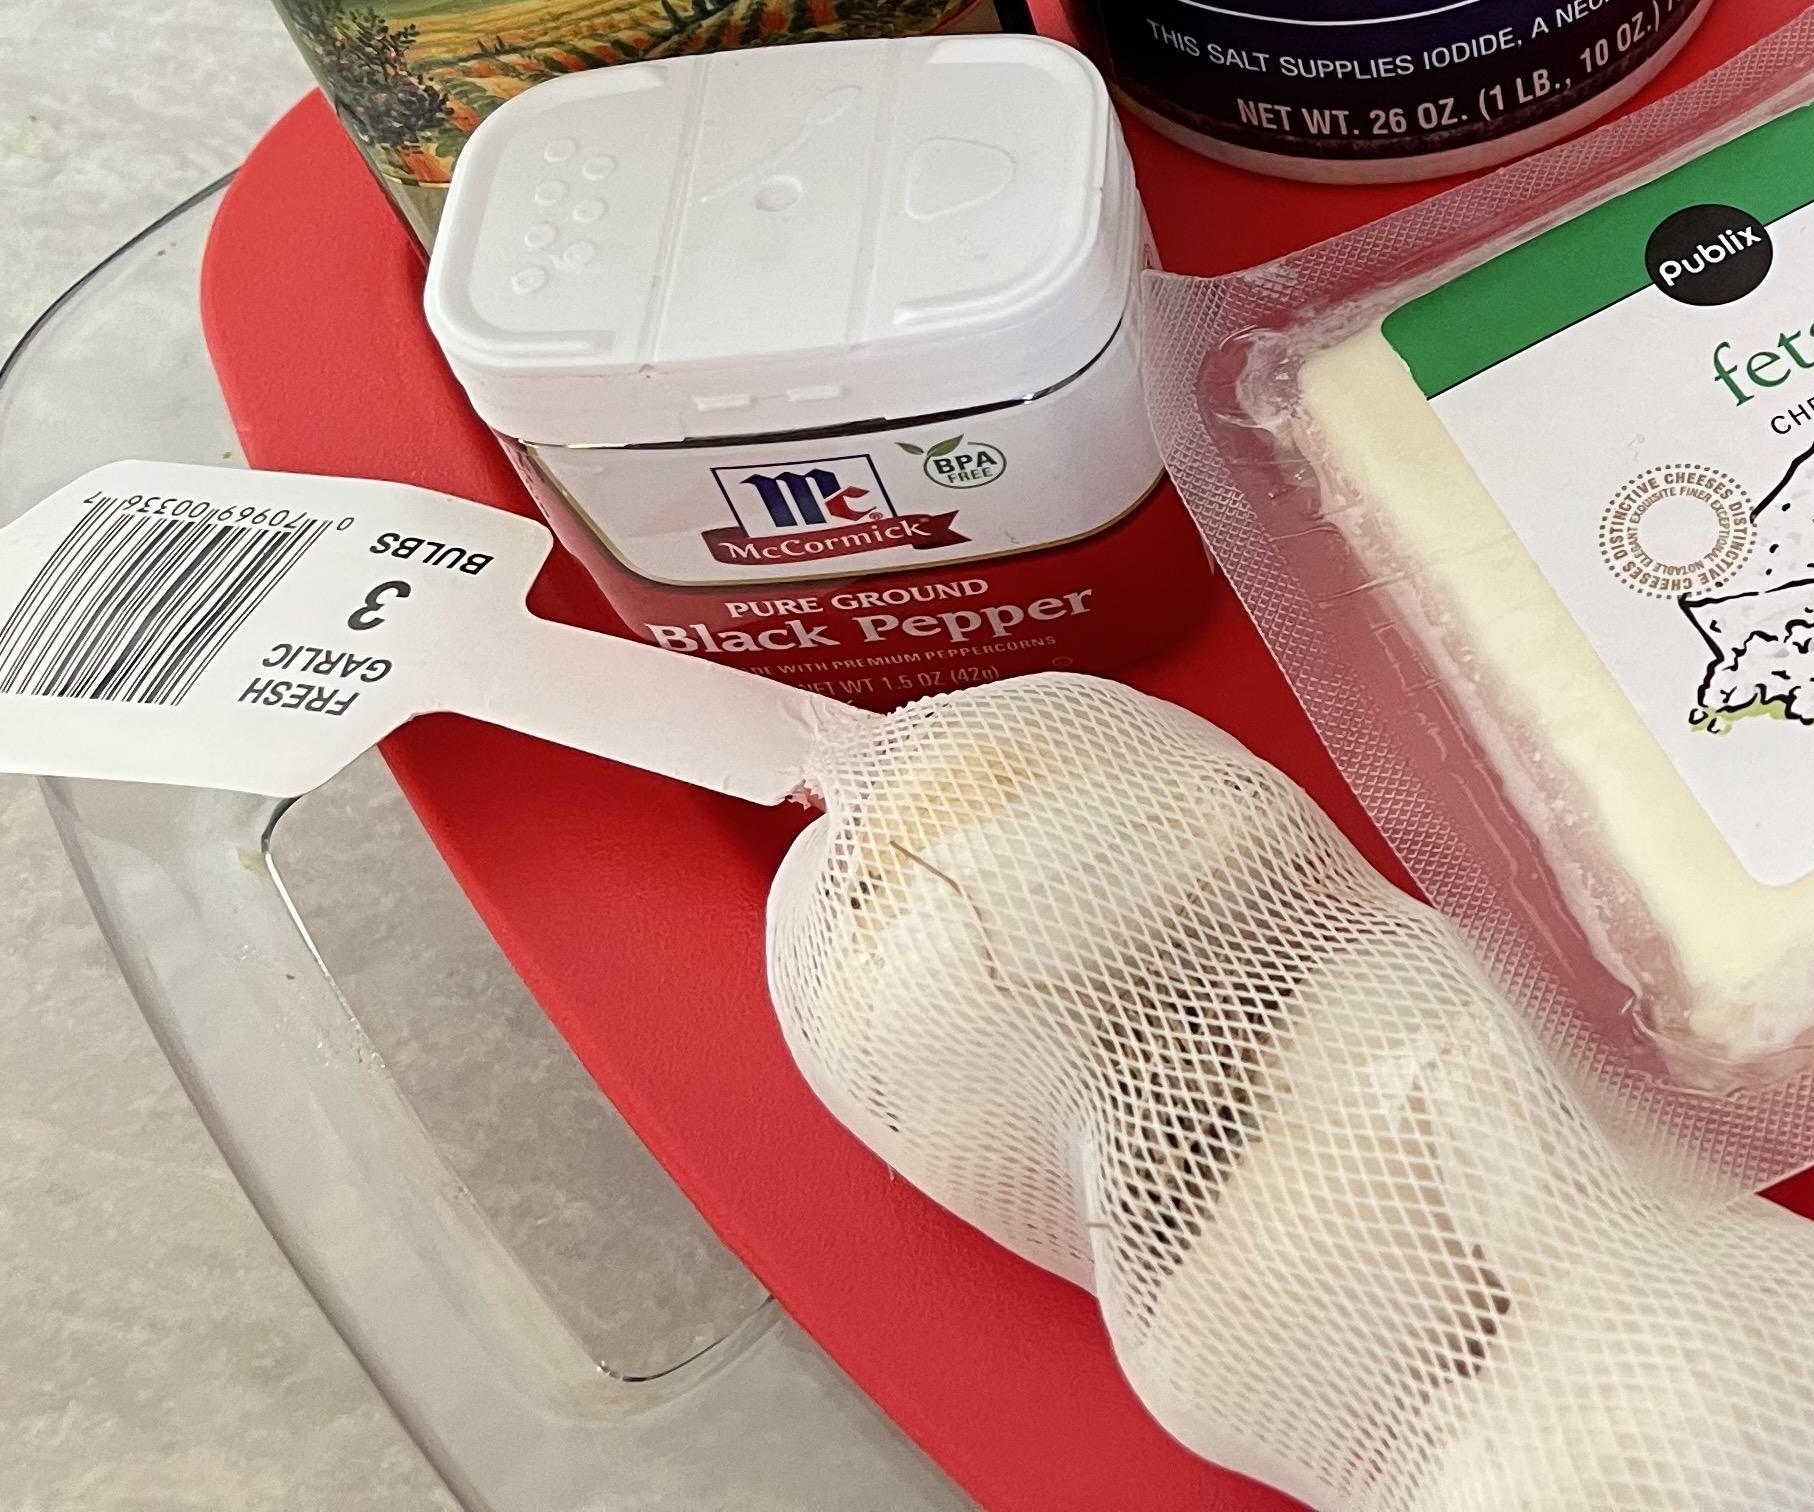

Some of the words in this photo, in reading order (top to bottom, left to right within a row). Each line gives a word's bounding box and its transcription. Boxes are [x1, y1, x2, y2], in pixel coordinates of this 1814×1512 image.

[1147, 18, 1200, 57] THIS
[1207, 41, 1269, 73] SALT
[1280, 54, 1414, 80] SUPPLIES
[1424, 28, 1523, 70] IODIDE,
[1531, 17, 1549, 39] A
[1237, 97, 1292, 132] NET
[1302, 108, 1360, 136] WT.
[1369, 108, 1406, 135] 26
[1417, 95, 1468, 127] OZ.
[1478, 82, 1505, 121] (1
[1580, 37, 1610, 74] 10
[1615, 8, 1662, 59] OZ.)
[1660, 224, 1762, 286] Publix
[933, 450, 997, 476] BPA
[947, 467, 993, 484] FREE
[124, 494, 209, 519] 00336
[218, 505, 308, 530] 70969
[370, 531, 495, 576] BULBS
[719, 520, 931, 561] McCormick
[347, 580, 412, 631] 3
[724, 597, 824, 619] PURE
[831, 578, 989, 612] GROUND
[646, 620, 840, 656] Black
[852, 588, 1095, 644] Pepper
[262, 643, 393, 684] GARLIC
[777, 662, 829, 675] WITH
[832, 652, 921, 670] PREMIUM
[924, 636, 1057, 661] PEPPERCORNS
[239, 677, 360, 717] FRESH
[838, 677, 874, 694] WT
[918, 670, 941, 687] OZ
